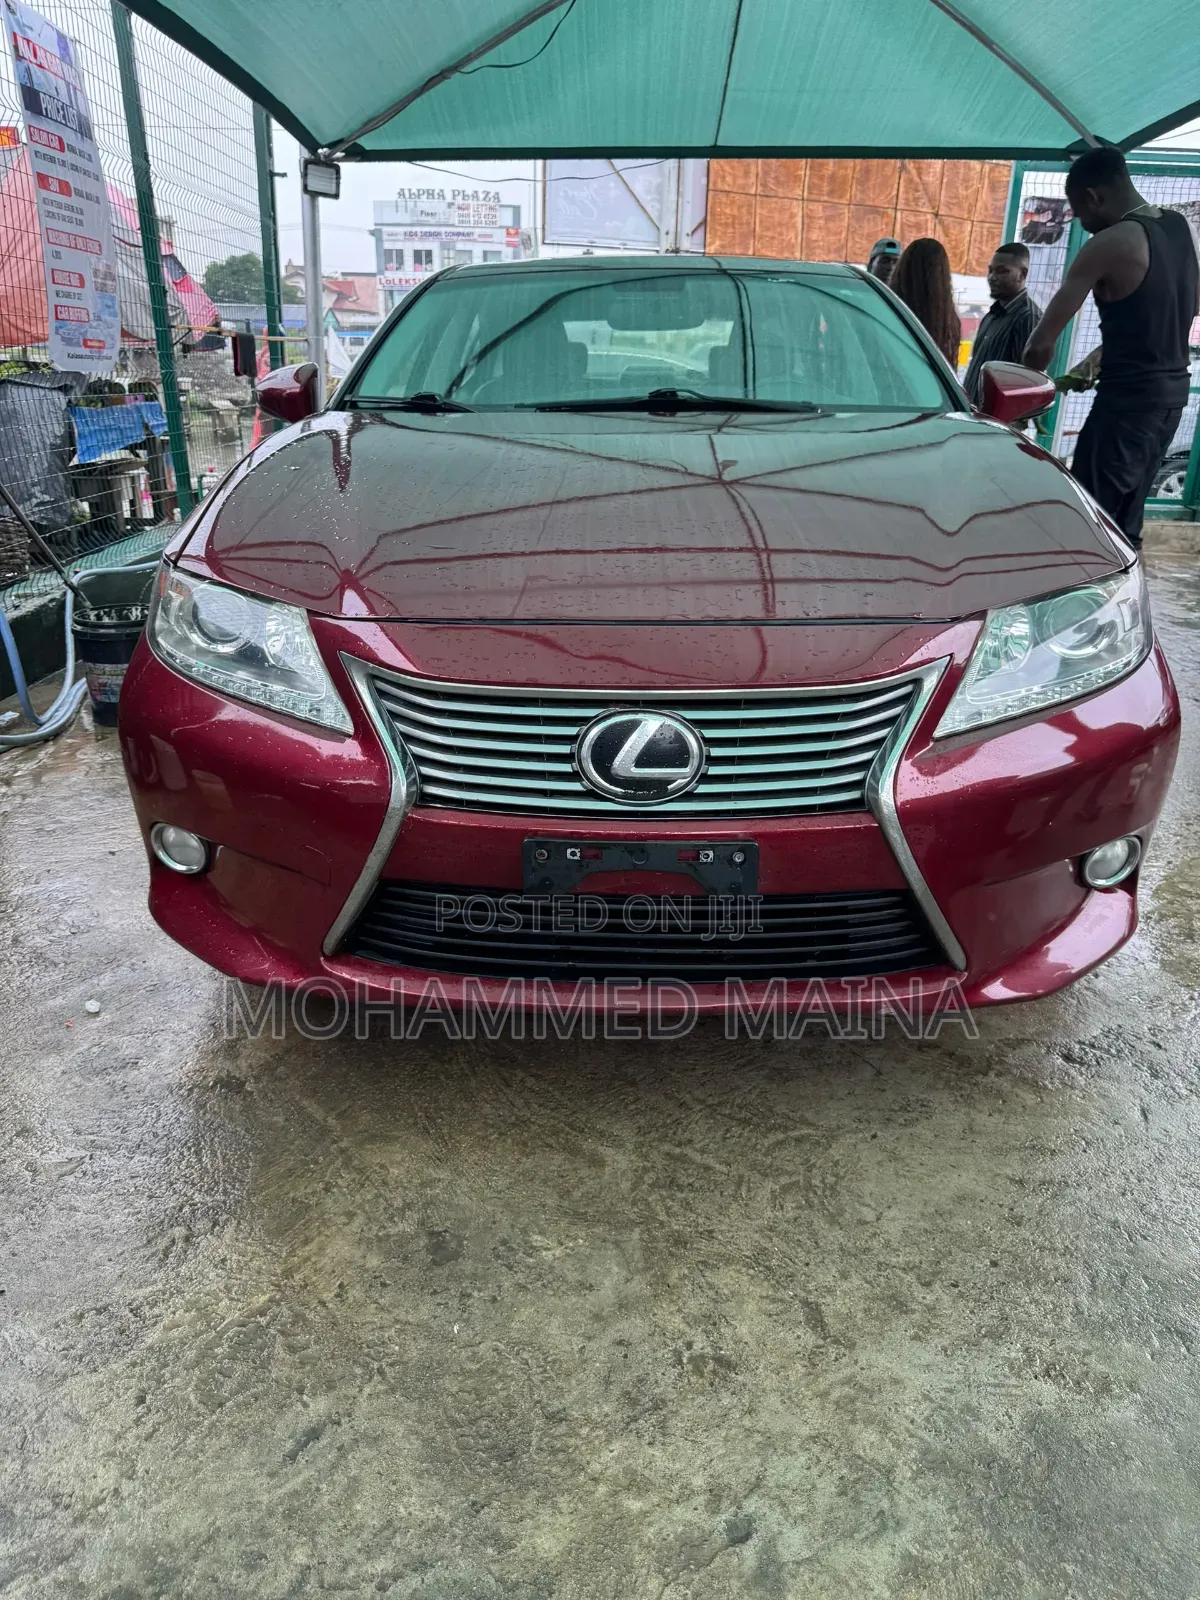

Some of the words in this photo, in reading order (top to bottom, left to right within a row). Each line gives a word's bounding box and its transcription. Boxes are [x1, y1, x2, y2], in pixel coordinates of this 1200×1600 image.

[39, 92, 65, 124] PRICE
[64, 104, 80, 132] LIST
[49, 134, 61, 150] CAR
[397, 188, 446, 201] ALPHA
[452, 189, 501, 203] PLAZA
[57, 306, 69, 320] CAR
